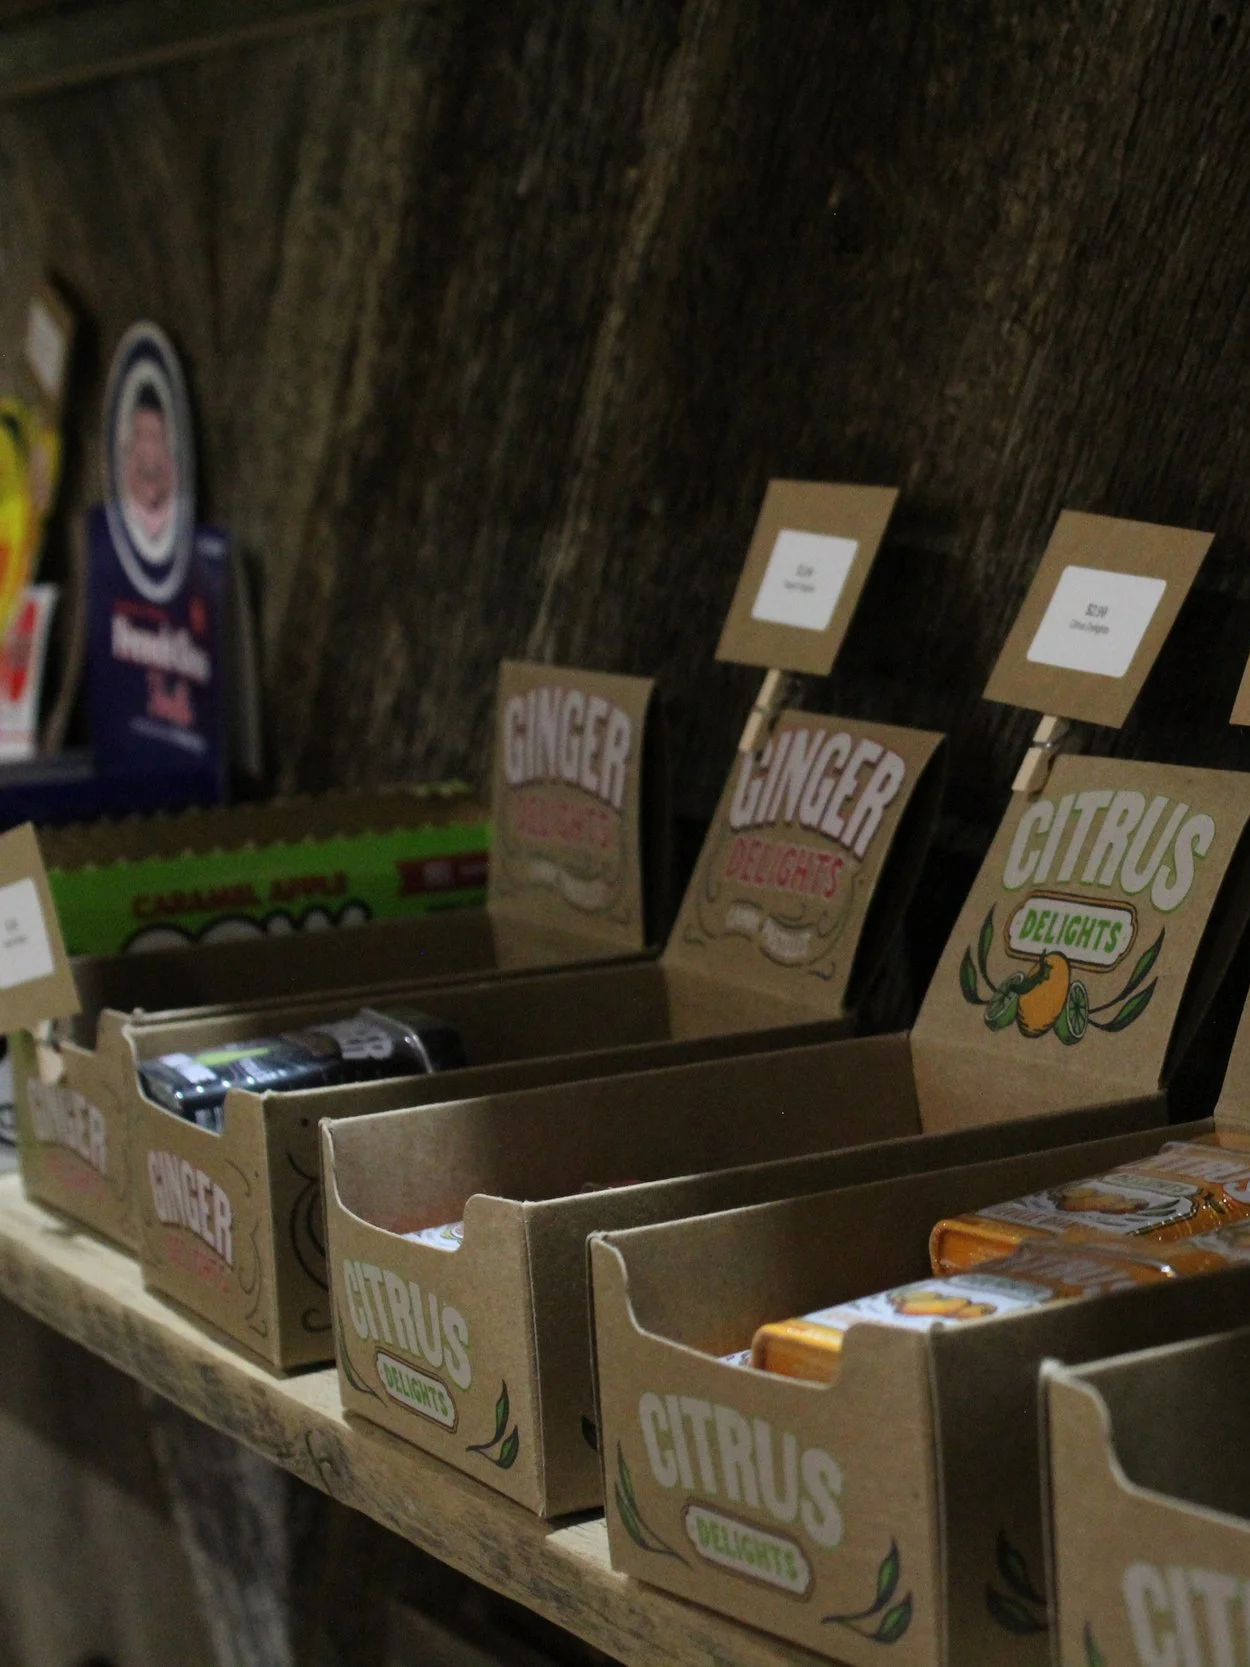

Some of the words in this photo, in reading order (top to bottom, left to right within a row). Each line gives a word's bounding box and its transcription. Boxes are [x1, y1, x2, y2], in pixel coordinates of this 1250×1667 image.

[503, 684, 632, 812] GINGER
[729, 728, 907, 858] GINGER
[725, 836, 845, 900] DELIGHTS
[1002, 789, 1216, 914] CITRUS
[1018, 907, 1125, 955] DELIGHTS
[147, 1149, 233, 1268] GINGER
[342, 1257, 473, 1392] CITRUS
[383, 1359, 452, 1417] DELIGHTS
[638, 1390, 846, 1551] CITRUS
[696, 1514, 800, 1584] DELIGHTS
